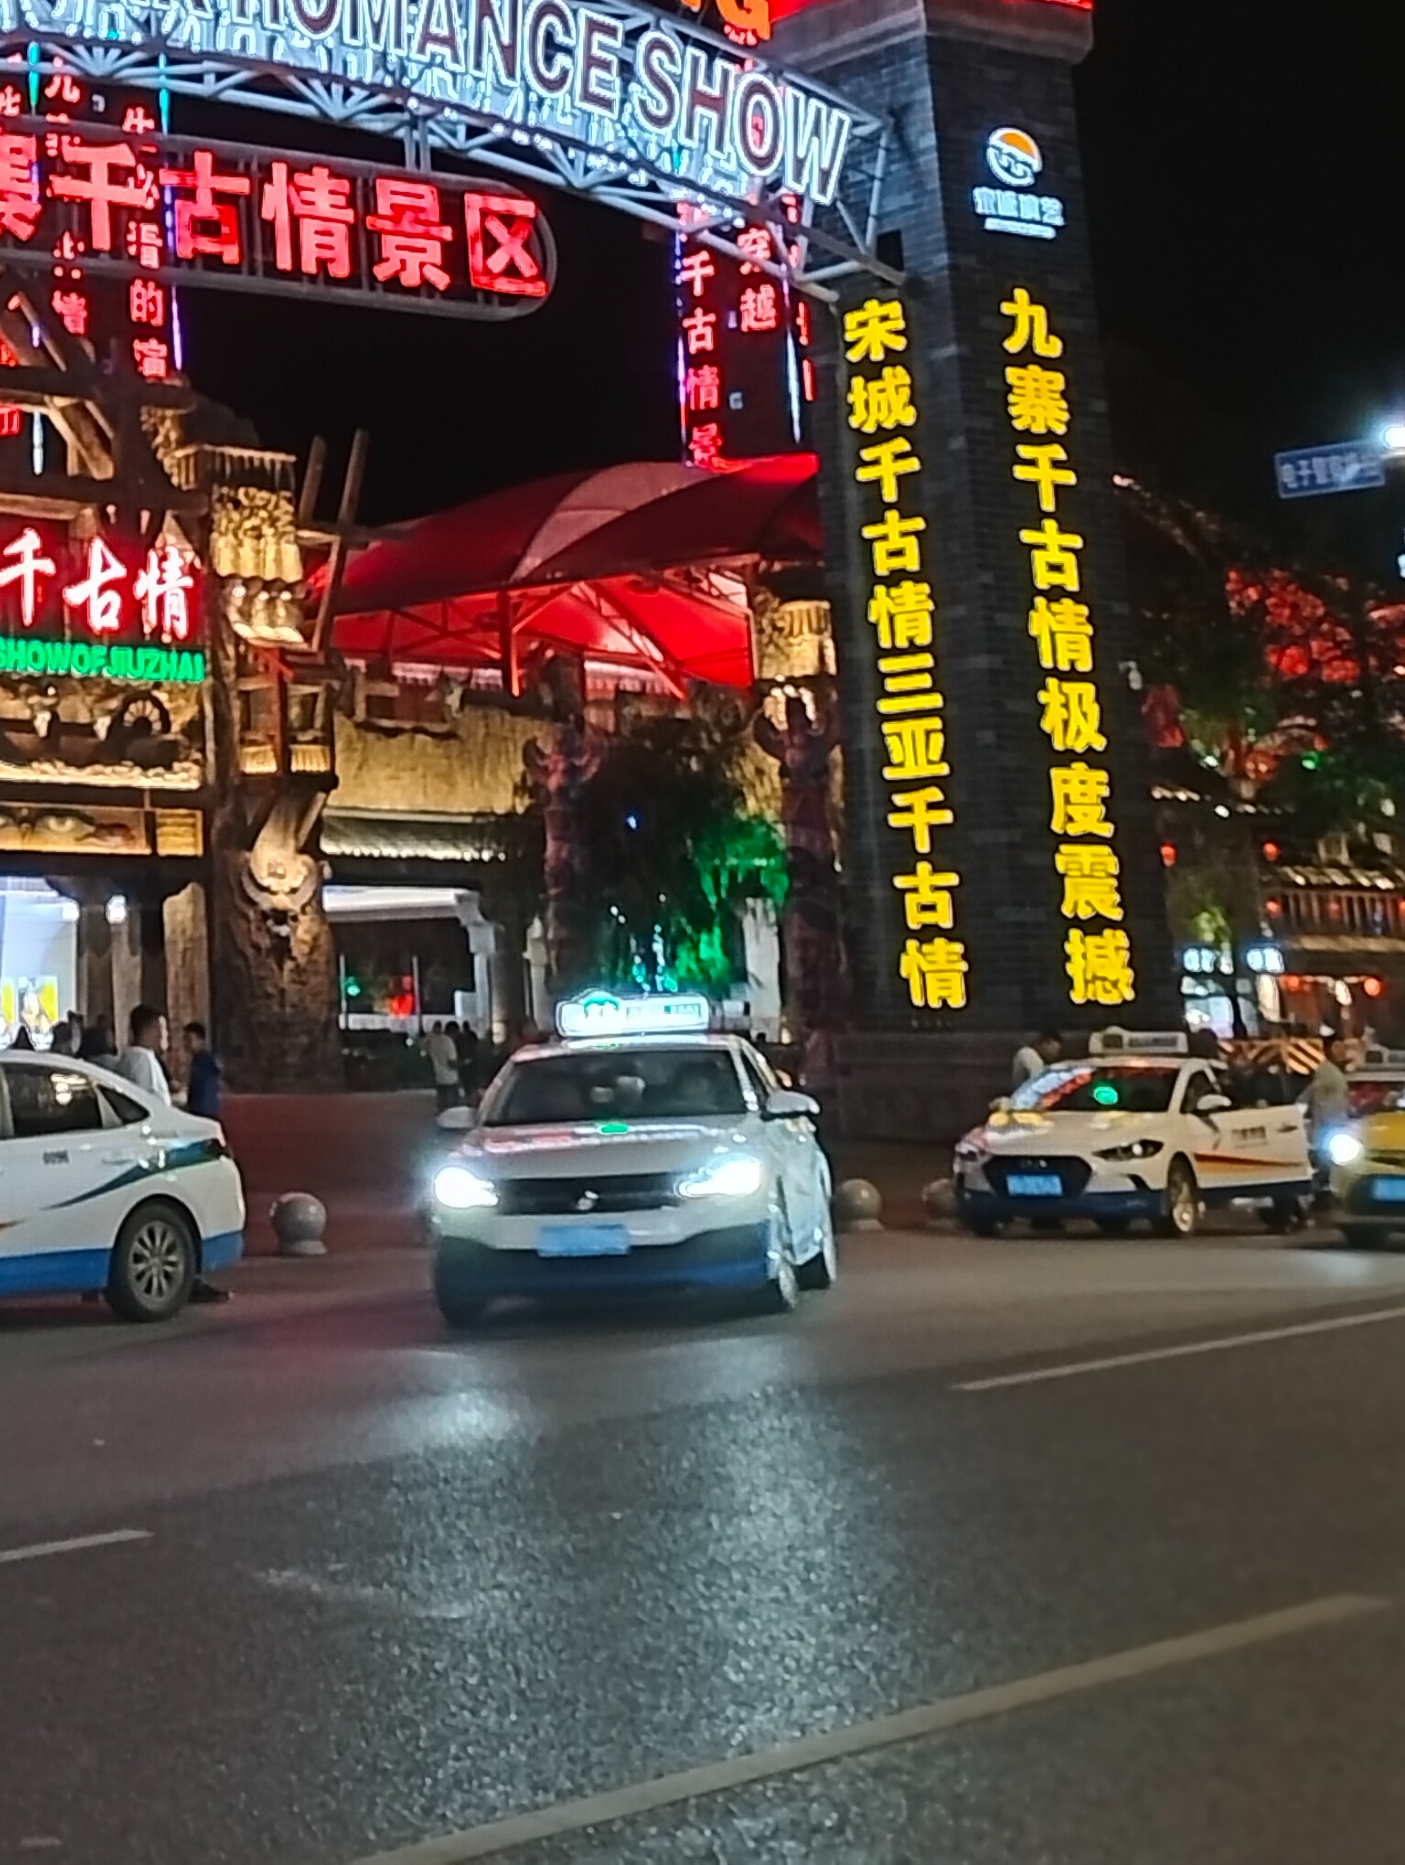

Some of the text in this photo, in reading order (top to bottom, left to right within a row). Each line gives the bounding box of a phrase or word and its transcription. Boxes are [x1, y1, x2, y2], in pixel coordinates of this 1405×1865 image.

[636, 19, 851, 205] SHOW
[842, 298, 970, 1010] 宋城千古情三亚千古情
[999, 287, 1136, 1005] 九寨千古情极度震撼
